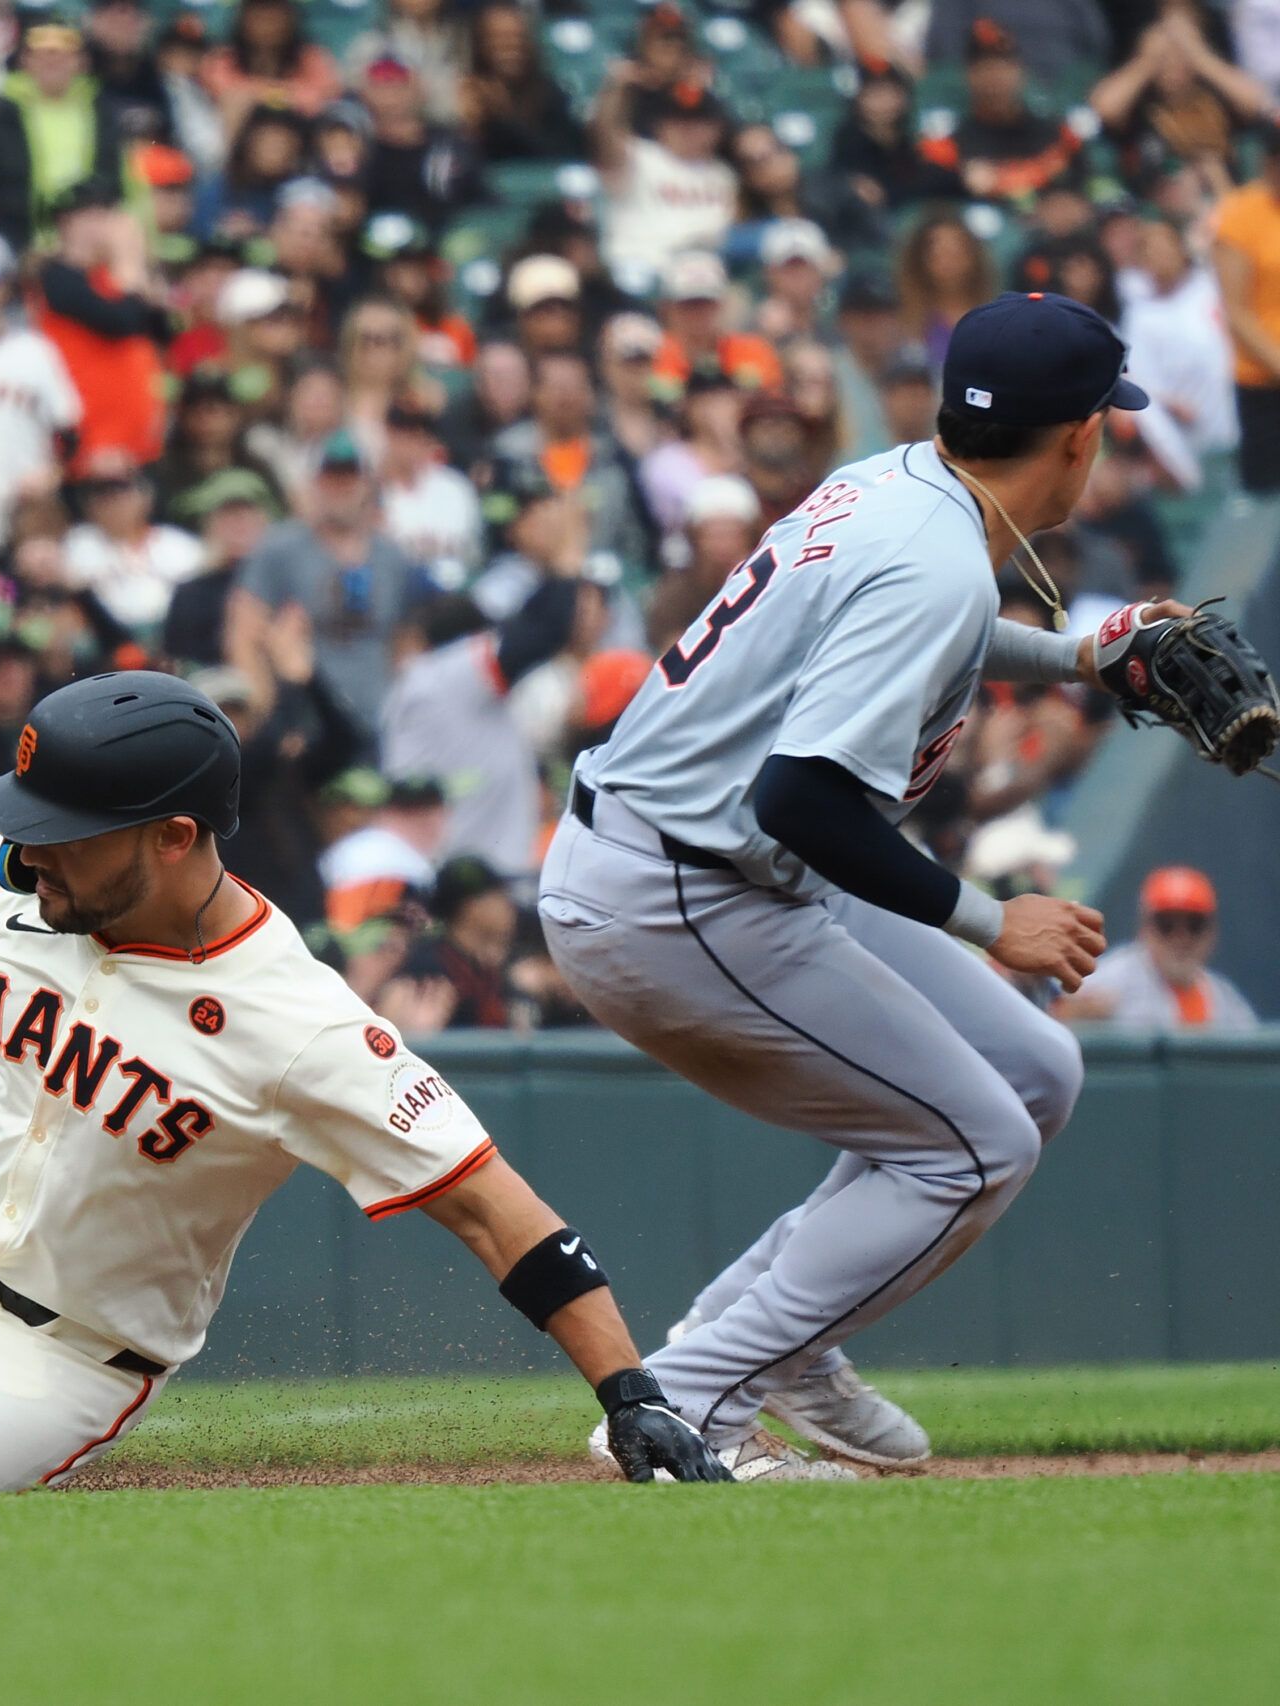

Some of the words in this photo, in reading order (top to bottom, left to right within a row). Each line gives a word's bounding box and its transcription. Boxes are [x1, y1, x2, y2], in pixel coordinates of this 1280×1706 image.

[658, 528, 779, 688] 3
[194, 1006, 218, 1030] 24
[373, 1033, 393, 1055] 30
[389, 1076, 453, 1133] GIANTS
[581, 1252, 597, 1270] 8
